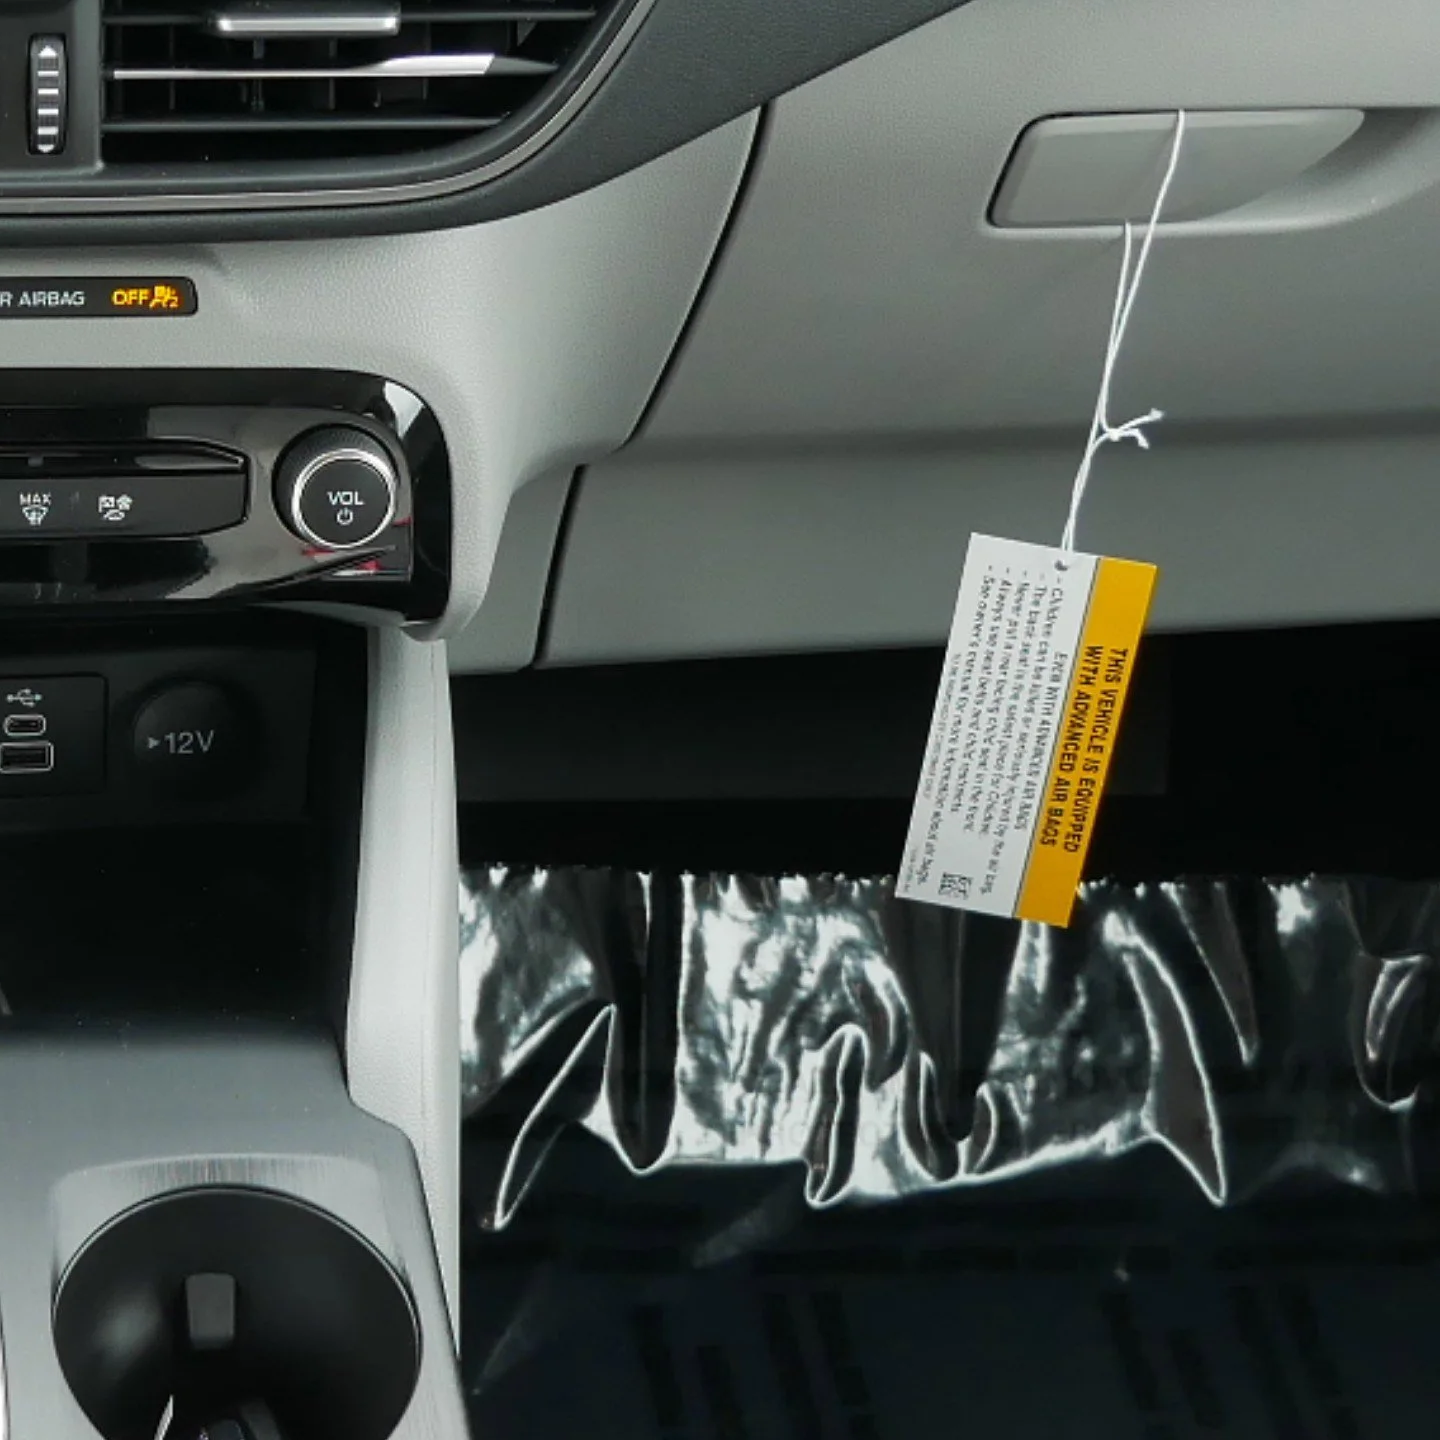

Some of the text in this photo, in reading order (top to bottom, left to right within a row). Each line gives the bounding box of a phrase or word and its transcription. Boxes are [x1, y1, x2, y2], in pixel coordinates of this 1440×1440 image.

[17, 290, 85, 307] AIRBAG
[111, 290, 149, 307] OFF
[19, 491, 52, 506] MAX
[326, 490, 366, 506] VOL
[163, 728, 216, 755] 12V
[1040, 642, 1102, 848] WITH ADVANCED AIR BAGS
[1063, 645, 1126, 854] THIS VEHICLE IS EQUIPPED
